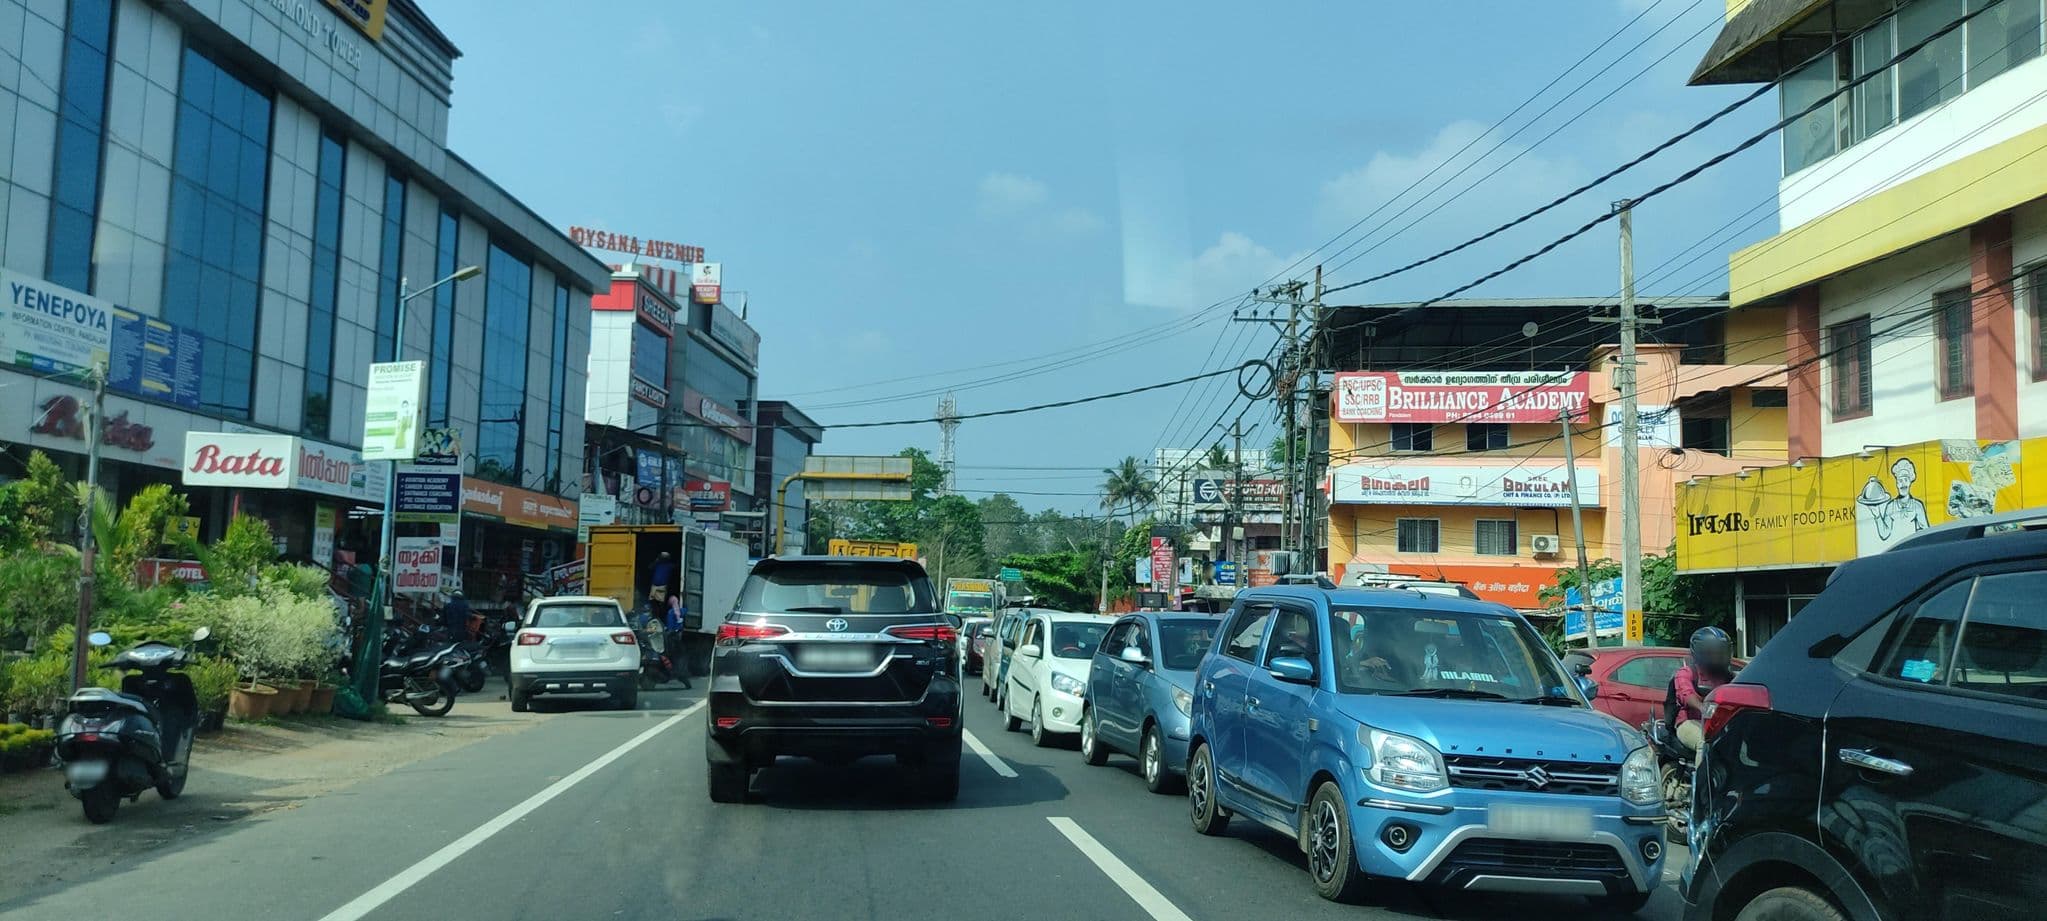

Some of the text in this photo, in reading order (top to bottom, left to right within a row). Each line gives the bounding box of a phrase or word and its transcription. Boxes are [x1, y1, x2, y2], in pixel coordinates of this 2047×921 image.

[322, 22, 361, 71] TOWER
[645, 239, 706, 263] AVENUE
[11, 281, 108, 331] YENEPOYA
[374, 362, 417, 375] PROMISE
[1388, 386, 1585, 410] BRILLIANCE ACADEMY
[189, 444, 285, 477] Bata
[1223, 483, 1263, 494] SEOND
[1687, 506, 1857, 536] IFTAR FAMILY FOOD PARK
